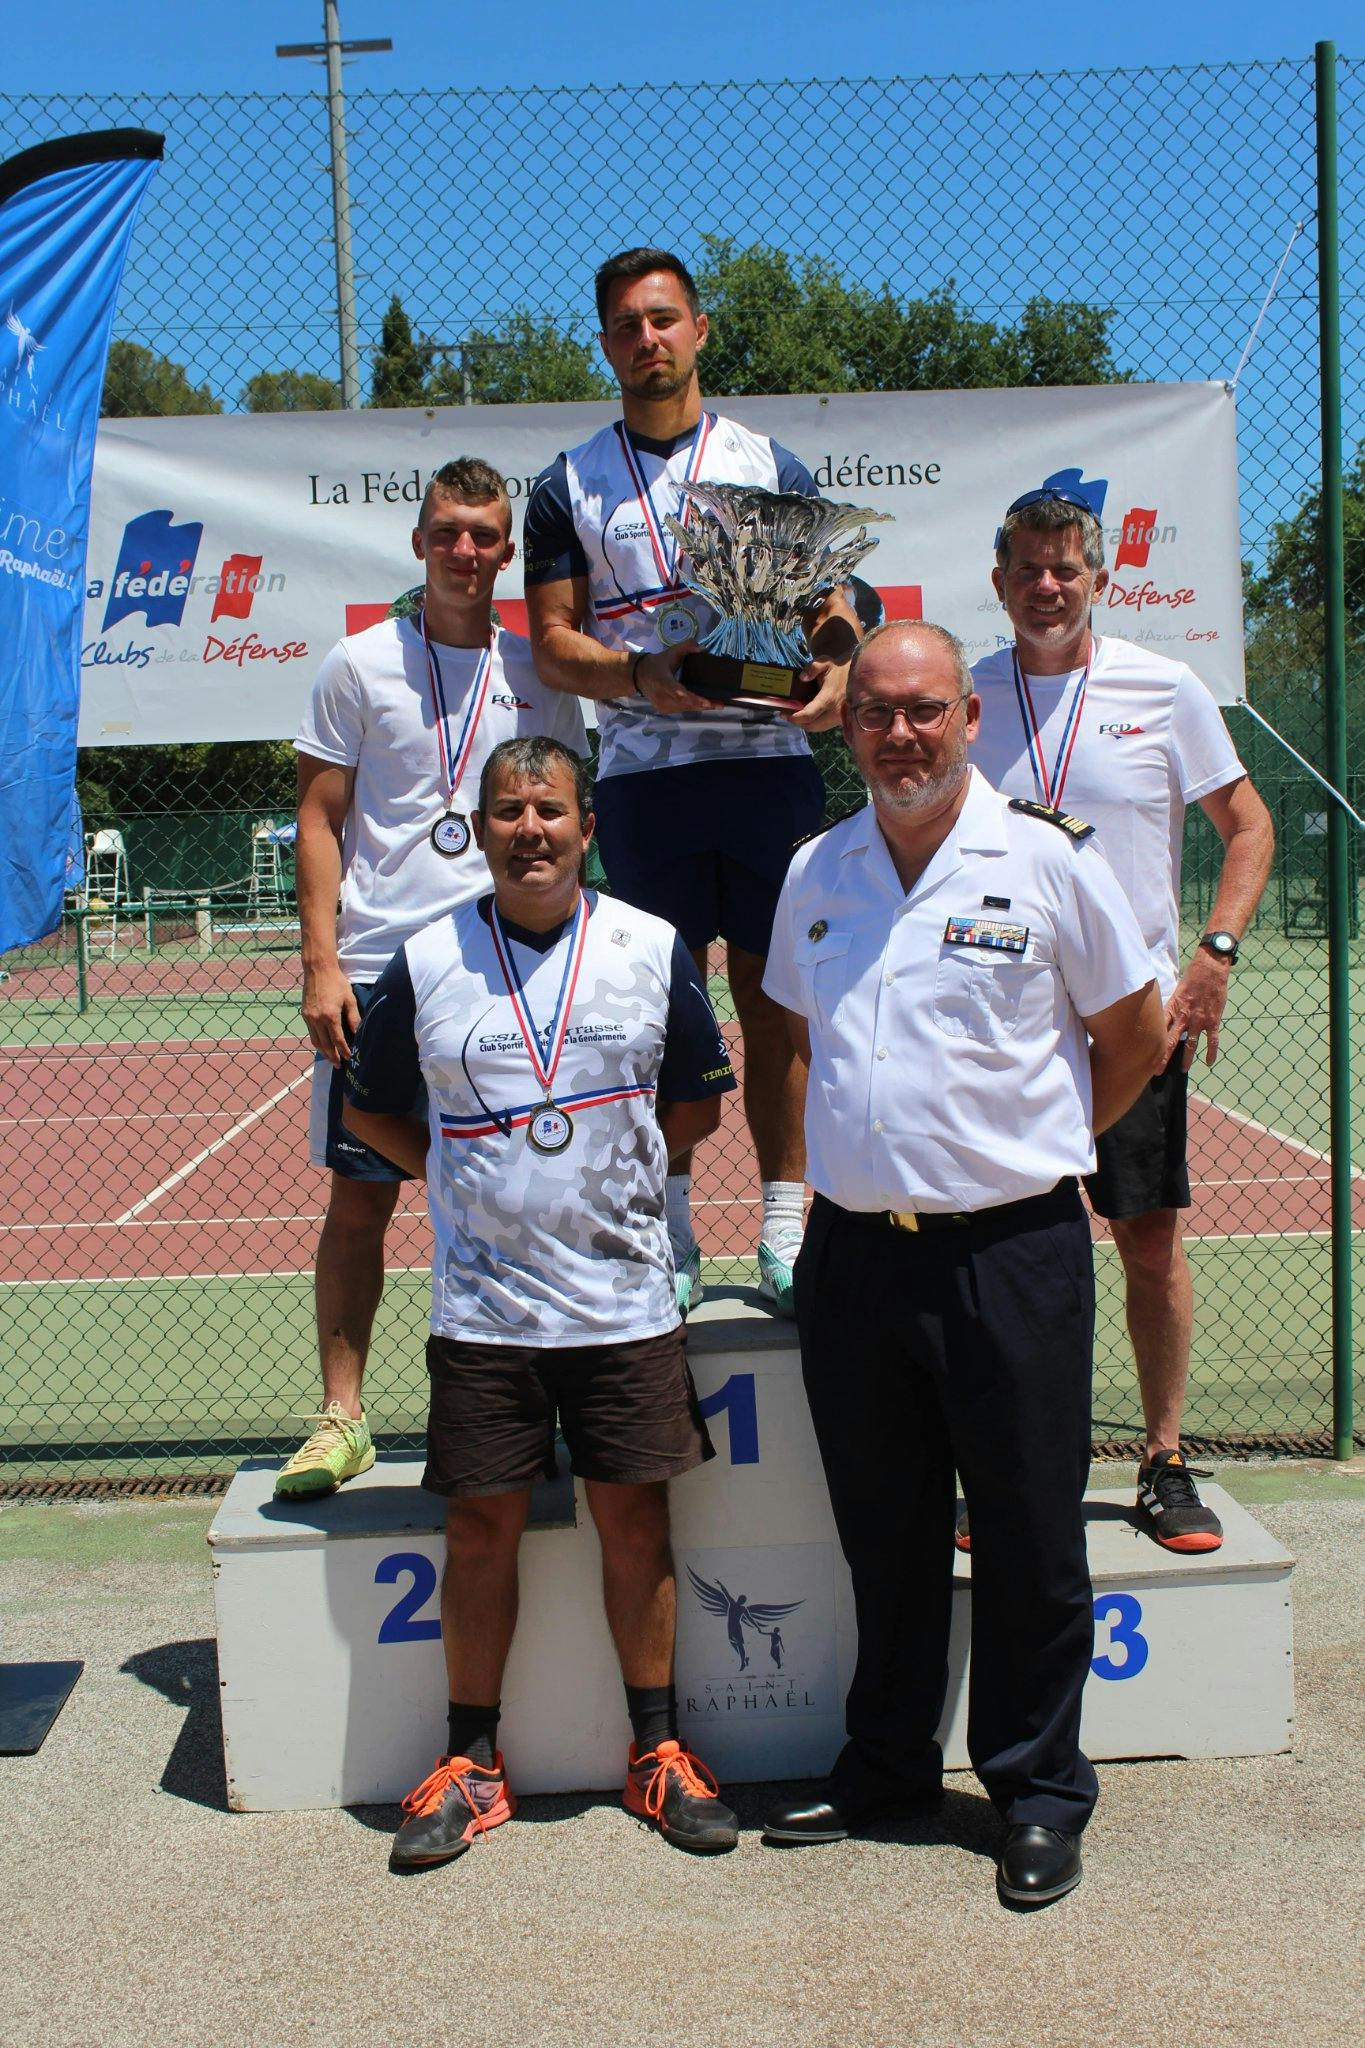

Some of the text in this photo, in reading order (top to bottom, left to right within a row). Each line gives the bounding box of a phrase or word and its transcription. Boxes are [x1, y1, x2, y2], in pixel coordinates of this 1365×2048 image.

[308, 475, 350, 505] La
[813, 454, 941, 488] défense
[631, 529, 650, 540] Sporti
[114, 560, 286, 598] fédération
[1107, 580, 1196, 612] Défense
[81, 641, 154, 668] Clubs
[203, 633, 309, 667] Défense
[491, 694, 521, 704] FCD
[1099, 723, 1131, 734] FCD
[479, 1041, 497, 1053] Club
[498, 1040, 523, 1052] Sportif
[578, 1033, 627, 1044] Gendarmerie
[701, 1374, 760, 1466] 1
[374, 1552, 442, 1644] 2
[1090, 1593, 1149, 1681] 3
[687, 1690, 816, 1713] RAPHAËL
[705, 1679, 796, 1694] SAINT
